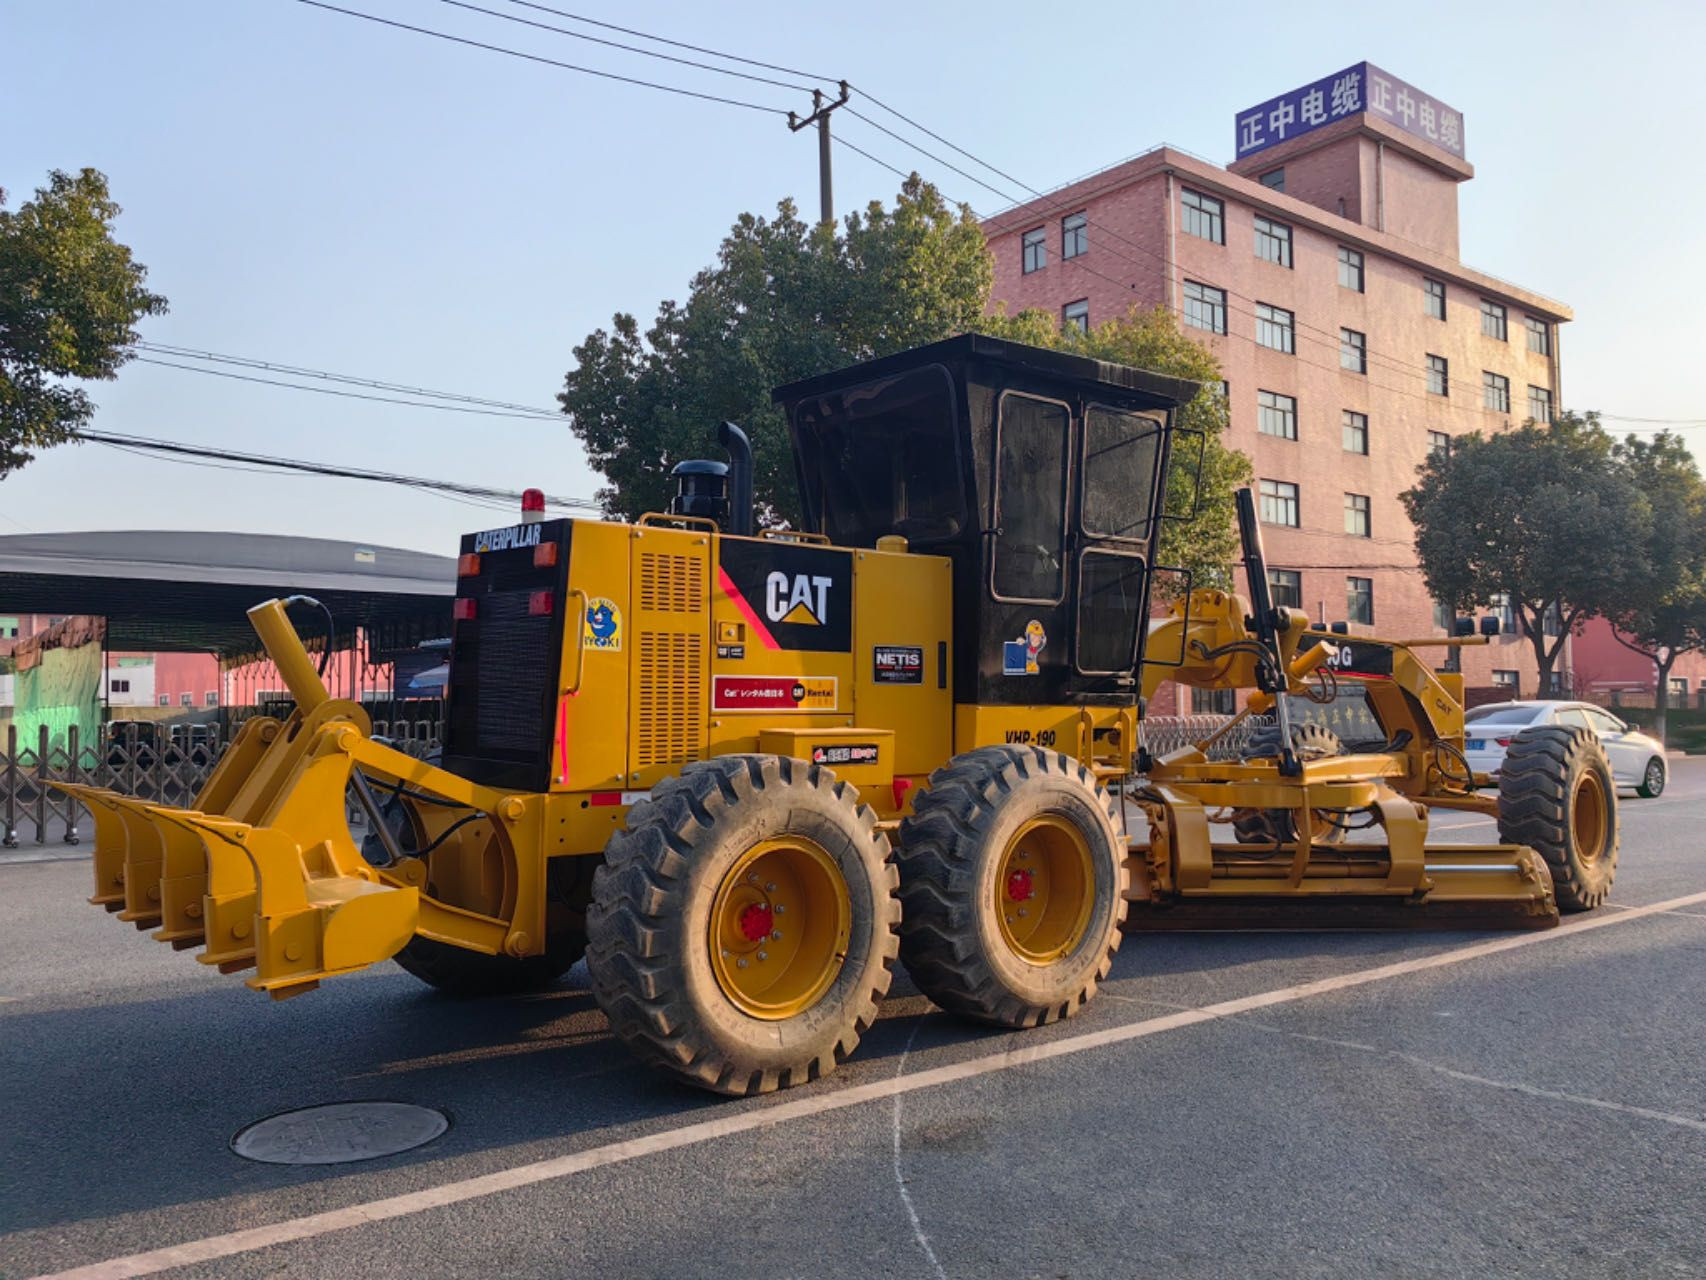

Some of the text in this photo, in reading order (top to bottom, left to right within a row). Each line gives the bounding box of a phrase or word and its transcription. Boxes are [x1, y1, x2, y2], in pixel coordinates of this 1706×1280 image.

[1239, 71, 1362, 153] 正中电缆
[1372, 74, 1461, 151] 正中电缆
[474, 523, 542, 553] CATERPILLAR
[766, 570, 833, 625] CAT
[876, 652, 921, 666] NETIS
[1005, 729, 1057, 747] VHP-190
